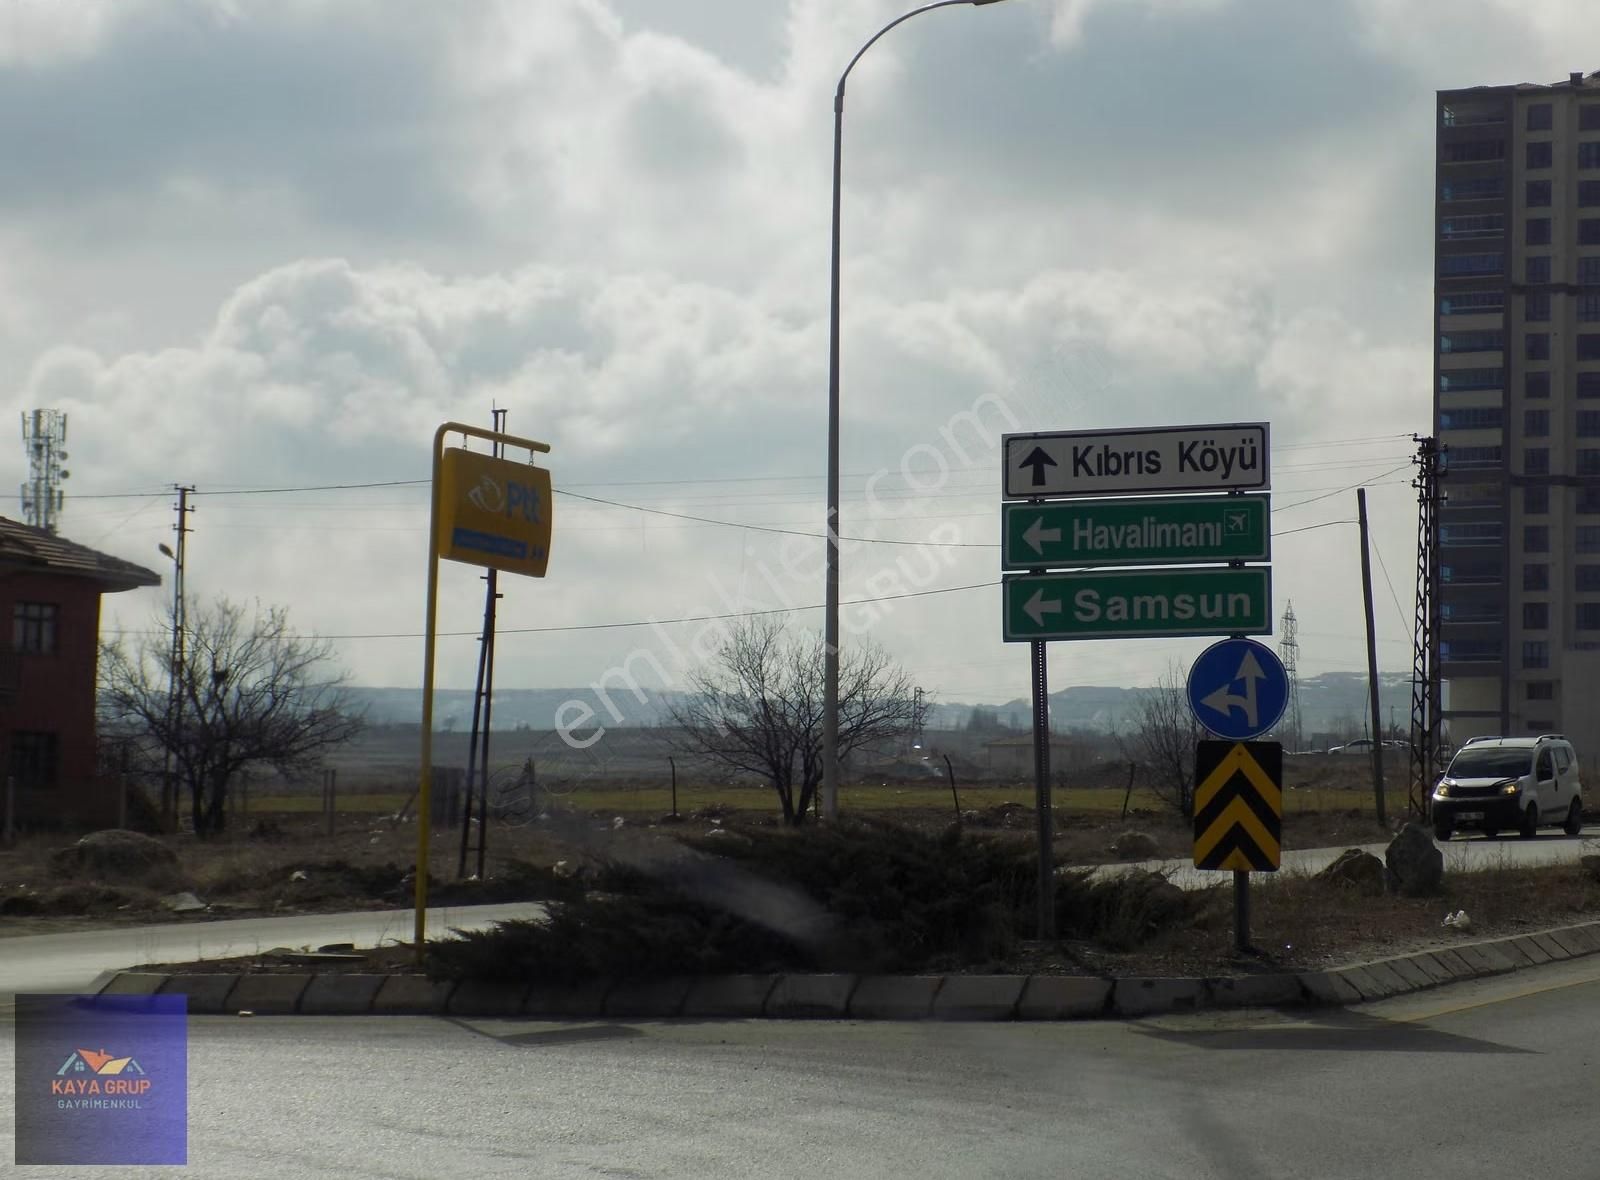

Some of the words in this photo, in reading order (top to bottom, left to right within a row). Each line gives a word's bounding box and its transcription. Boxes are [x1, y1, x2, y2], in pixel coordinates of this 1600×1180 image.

[1072, 444, 1162, 478] Kıbrıs
[1178, 438, 1257, 480] Köyü
[1073, 516, 1222, 550] Havalimanı
[1074, 589, 1251, 622] Samsun
